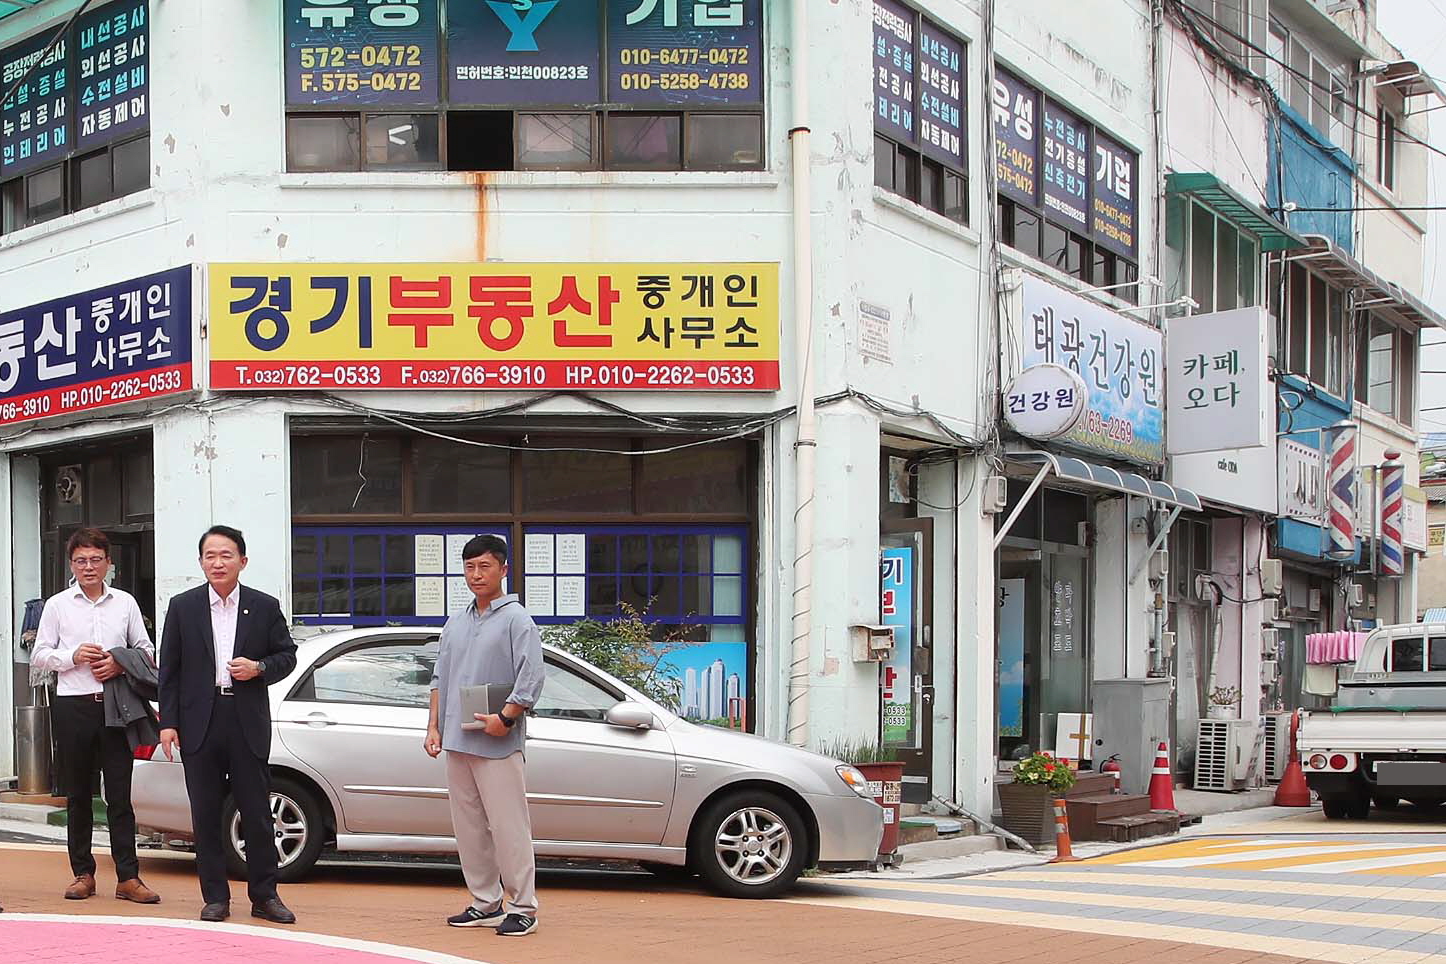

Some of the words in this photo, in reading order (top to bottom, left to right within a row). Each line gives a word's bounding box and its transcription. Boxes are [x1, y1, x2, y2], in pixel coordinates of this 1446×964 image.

[81, 5, 145, 50] 내선공사
[874, 3, 912, 44] 장전력공사
[81, 35, 145, 79] 외선공사
[300, 46, 421, 68] 572-0472
[620, 48, 748, 66] 010-6477-0472
[921, 32, 959, 73] 내선공사
[81, 65, 145, 107] 수전설비
[620, 72, 749, 91] 010-5258-4738
[878, 66, 912, 103] 전공사
[921, 61, 959, 101] 외선공사
[3, 96, 66, 137] 누전공사
[81, 95, 145, 137] 자동제어
[878, 96, 912, 132] 테리어
[921, 91, 959, 129] 수전설비
[994, 79, 1033, 141] 유성
[3, 125, 66, 165] 인테리어
[921, 119, 960, 157] 자동제어
[1045, 112, 1086, 153] 누전공사
[996, 139, 1033, 174] 72-0472
[1045, 137, 1086, 177] 전기증설
[1096, 145, 1131, 200] 기업
[1045, 162, 1086, 200] 신축전기
[90, 282, 171, 334] 중개인
[636, 274, 759, 309] 중개인
[229, 275, 621, 352] 경기부동산
[636, 317, 759, 349] 사무소
[90, 326, 172, 371] 사무소
[1032, 306, 1158, 407] 태광건강원
[1008, 387, 1075, 414] 건강원
[1183, 382, 1241, 410] 오다
